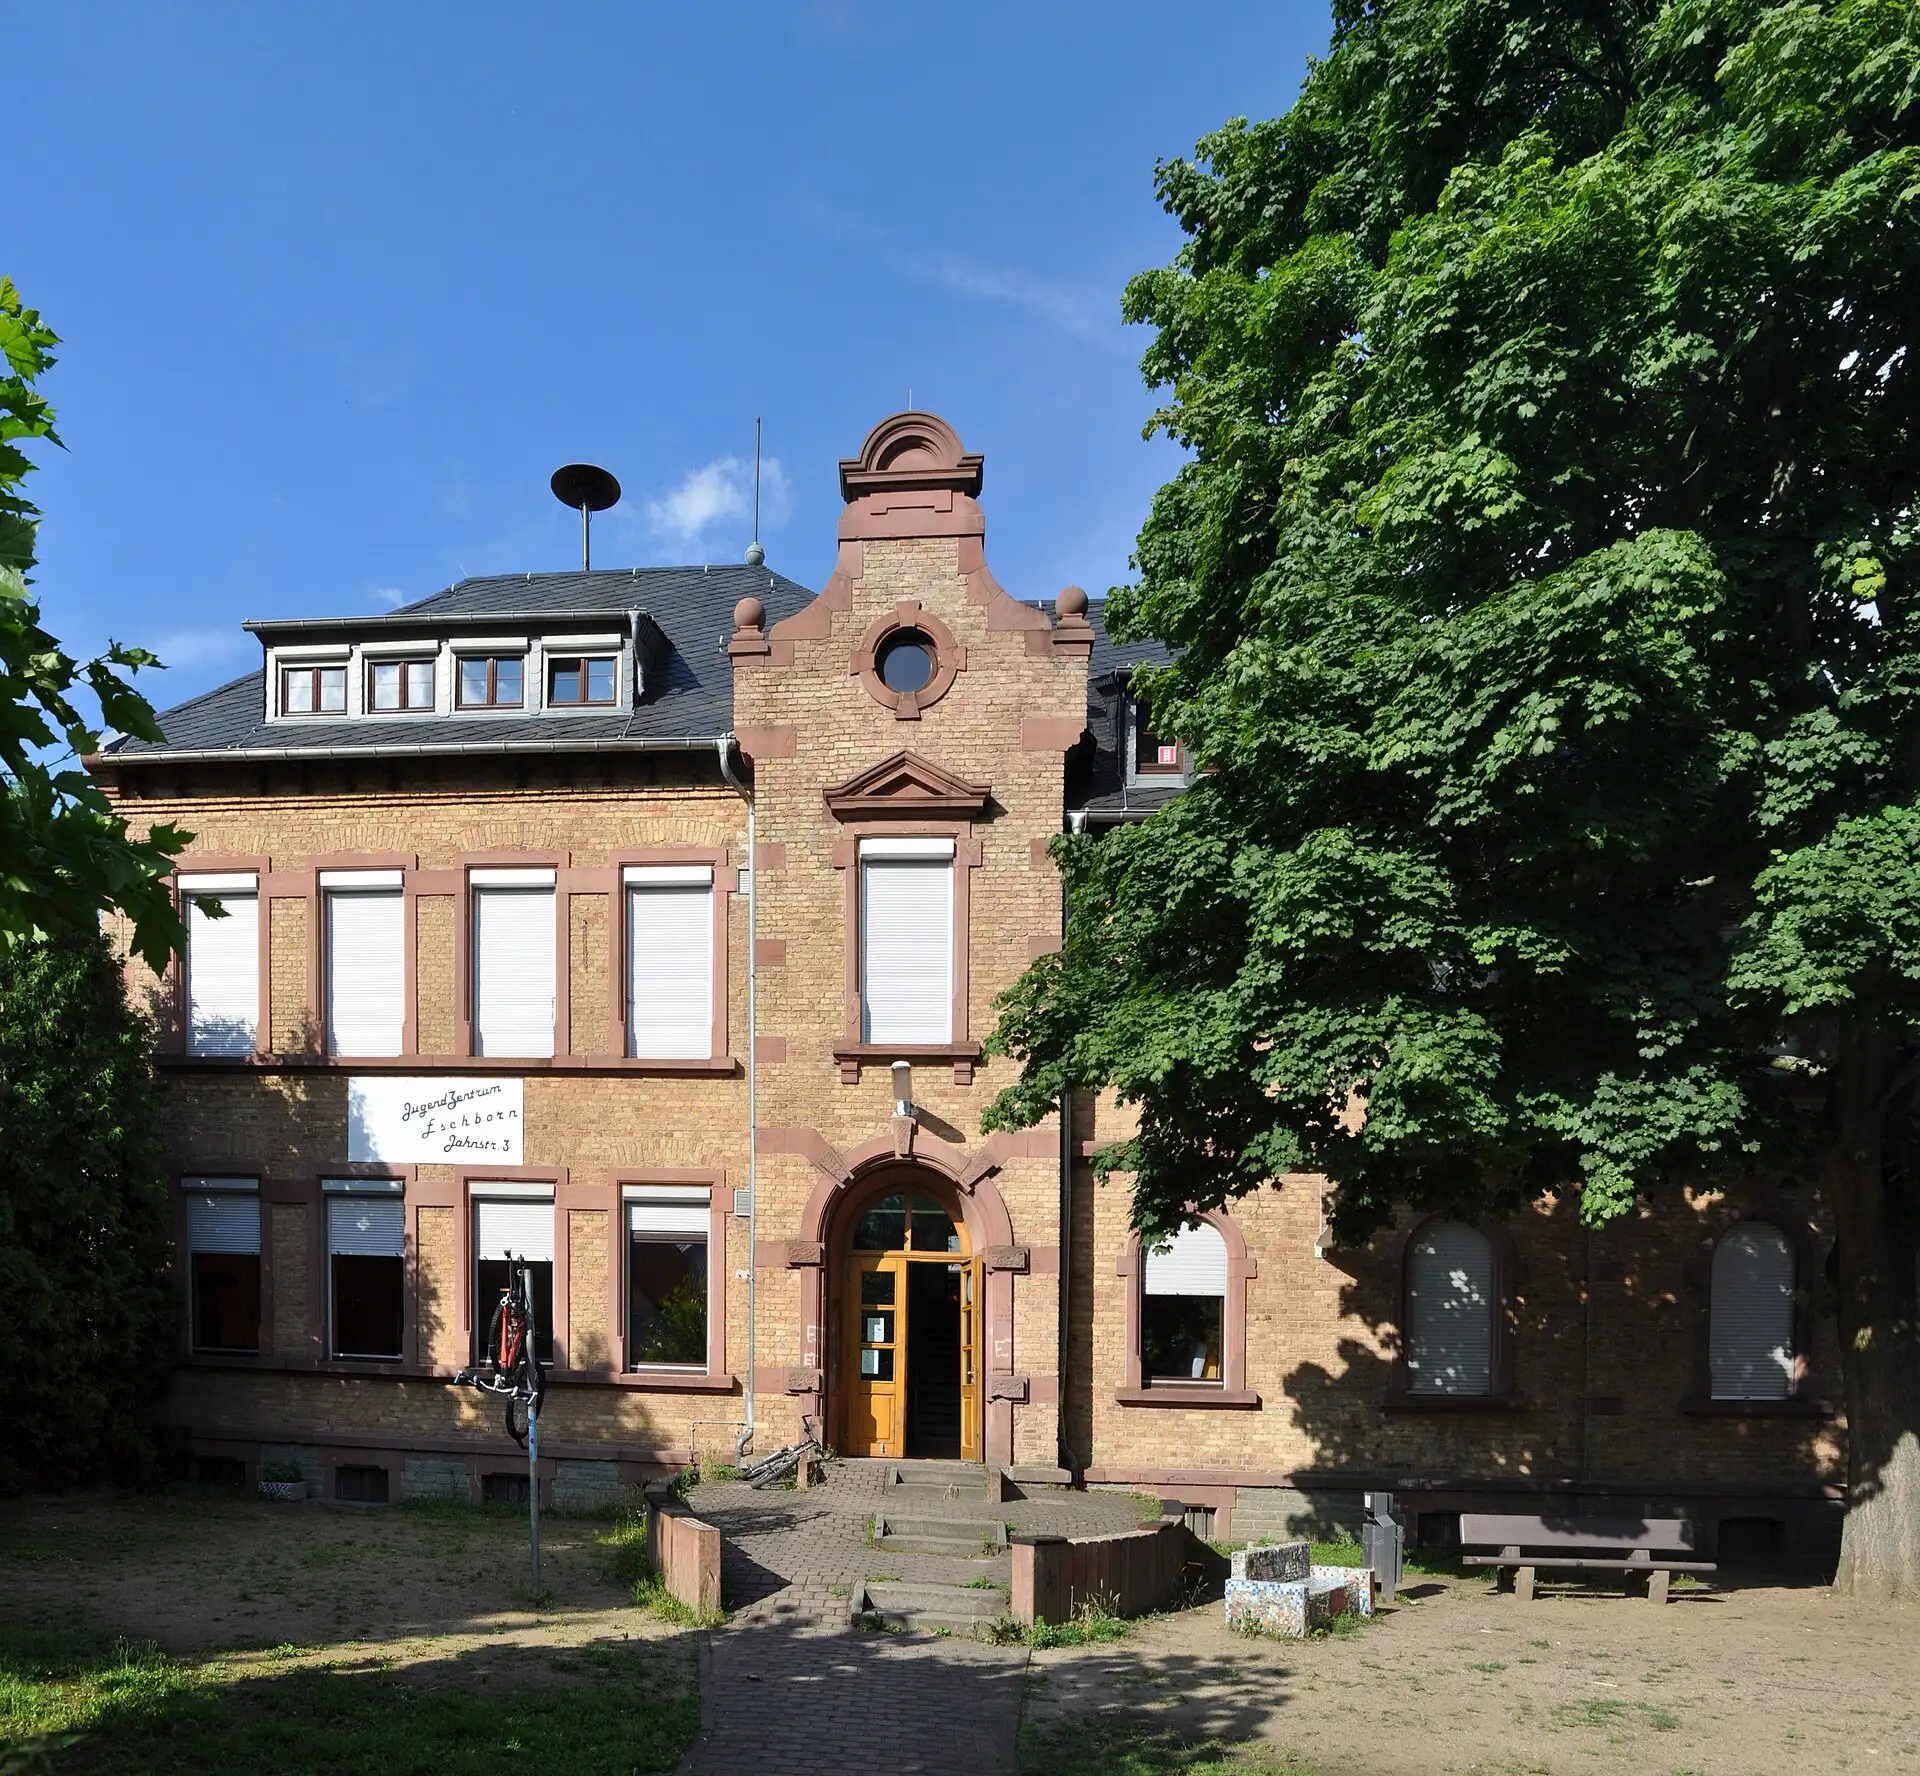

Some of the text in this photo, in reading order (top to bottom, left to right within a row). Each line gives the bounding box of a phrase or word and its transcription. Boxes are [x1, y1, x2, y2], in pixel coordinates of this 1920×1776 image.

[402, 1085, 502, 1122] JugendZentrum
[421, 1109, 518, 1139] Eschborn
[443, 1134, 510, 1153] Jahnstr. 3
